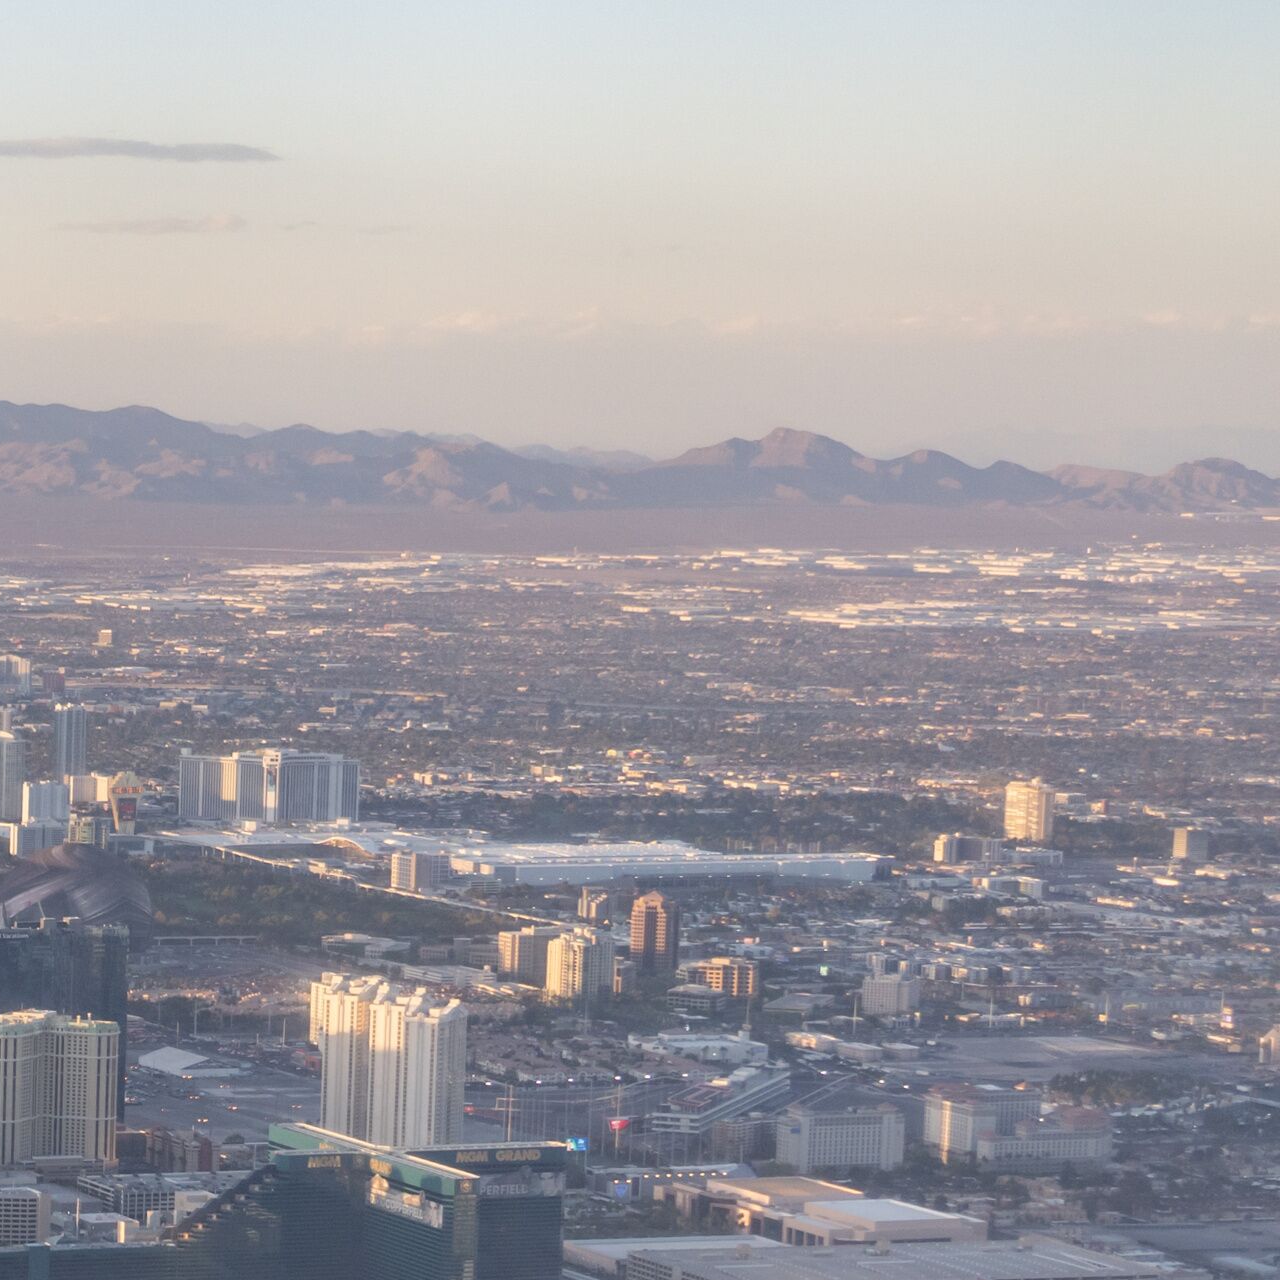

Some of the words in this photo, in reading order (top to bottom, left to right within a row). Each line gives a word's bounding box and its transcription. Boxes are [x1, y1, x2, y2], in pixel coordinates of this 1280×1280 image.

[307, 1155, 341, 1168] MGM
[455, 1151, 488, 1163] MGM
[495, 1149, 542, 1161] GRAND
